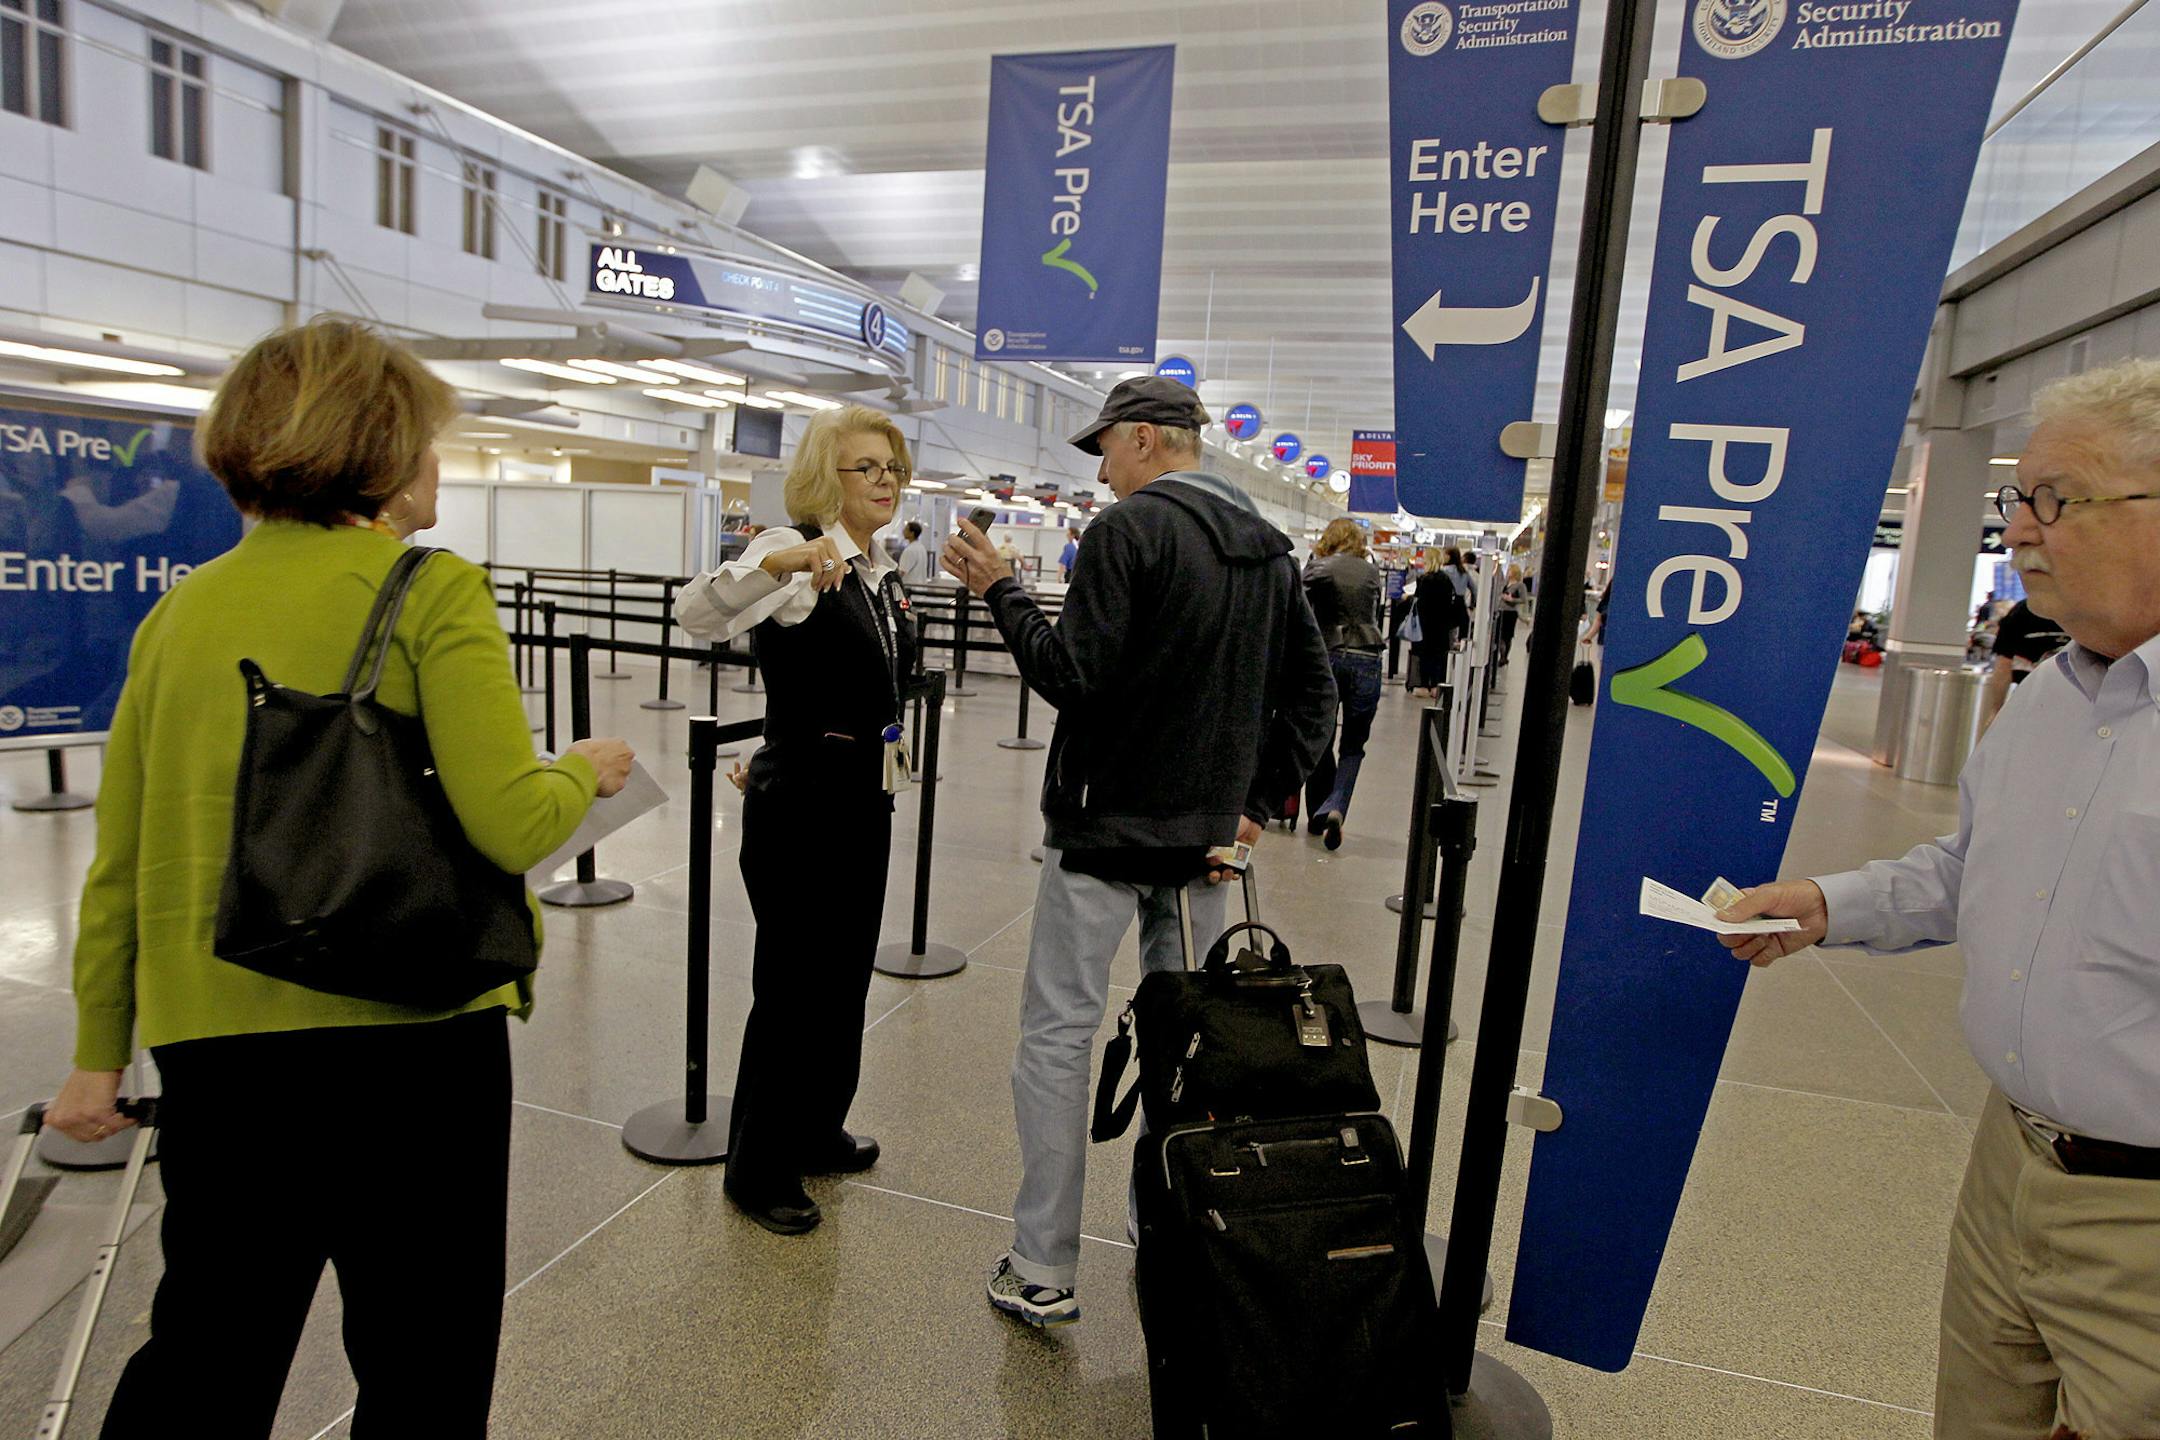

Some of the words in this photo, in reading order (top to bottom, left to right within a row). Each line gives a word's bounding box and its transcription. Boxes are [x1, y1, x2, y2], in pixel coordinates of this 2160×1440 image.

[1459, 0, 1569, 19] Transportation
[1796, 0, 1912, 24] Security
[1455, 29, 1568, 50] Administration
[1457, 18, 1520, 34] Security
[1791, 19, 2002, 50] Administration
[1056, 75, 1096, 158] TSA
[1408, 138, 1549, 182] Enter
[1050, 168, 1091, 235] Pre
[1408, 191, 1532, 234] Here
[597, 246, 643, 272] ALL
[1676, 127, 1834, 384] TSA
[595, 268, 675, 300] GATES
[870, 310, 881, 341] 4
[56, 429, 111, 461] Pre
[1366, 432, 1392, 440] DELTA
[1645, 423, 1791, 627] Pre
[0, 551, 126, 593] Enter
[136, 555, 201, 593] He
